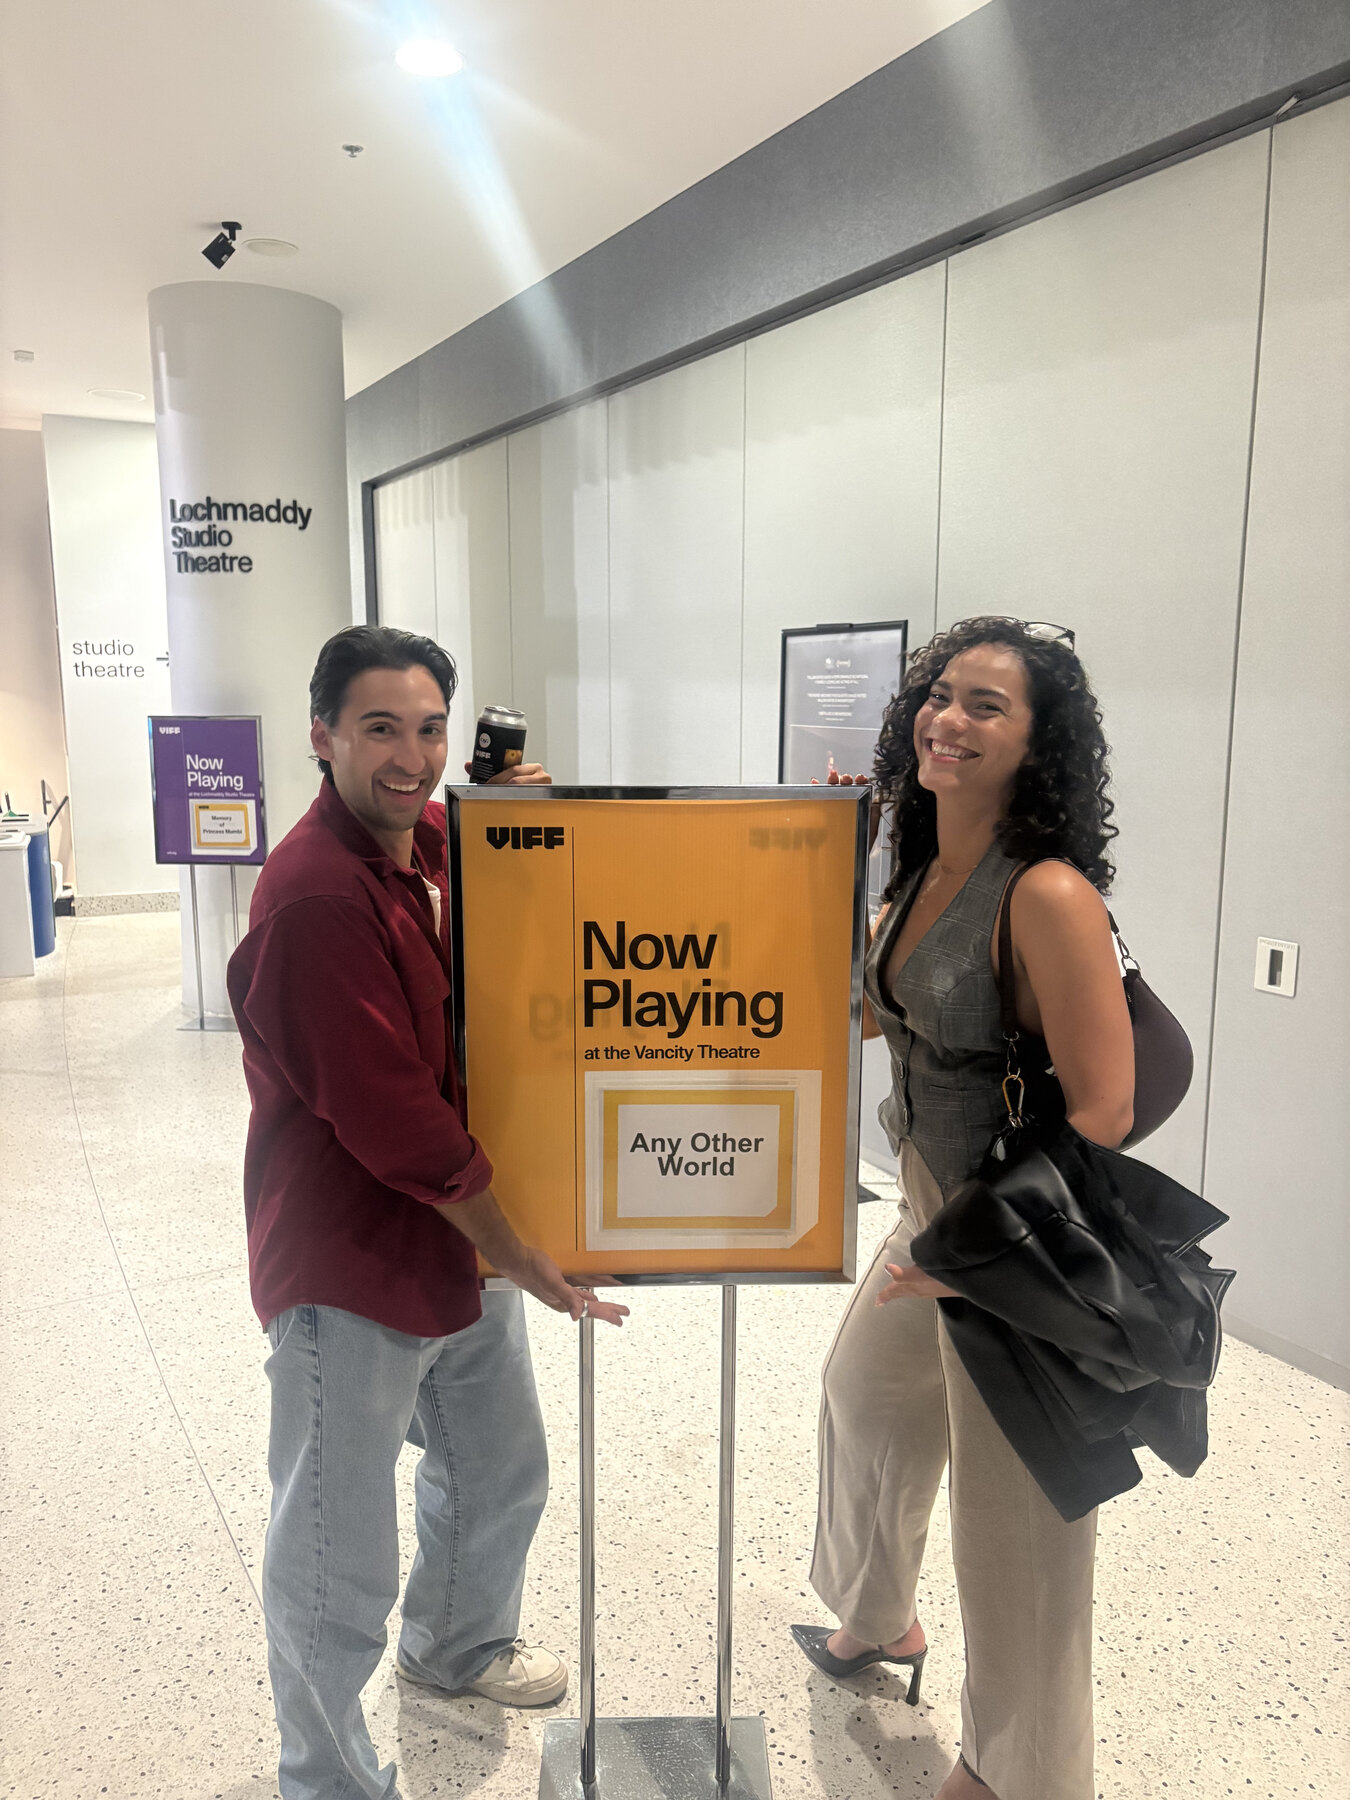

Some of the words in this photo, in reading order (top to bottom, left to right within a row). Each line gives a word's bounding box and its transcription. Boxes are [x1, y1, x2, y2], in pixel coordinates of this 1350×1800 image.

[170, 496, 312, 531] Lochmaddy
[171, 524, 233, 549] Studio
[173, 551, 253, 573] Theatre
[72, 639, 134, 656] studio
[73, 660, 145, 678] theatre
[159, 726, 181, 735] VIFF
[186, 754, 223, 770] Now
[187, 771, 244, 791] Playing
[486, 826, 565, 850] VIFF
[583, 920, 718, 971] Now
[583, 978, 784, 1039] Playing
[584, 1046, 600, 1060] at
[604, 1046, 630, 1060] the
[634, 1045, 694, 1062] Vancity
[697, 1044, 761, 1059] Theatre
[629, 1132, 682, 1157] Any
[690, 1132, 764, 1153] Other
[657, 1155, 735, 1176] World
